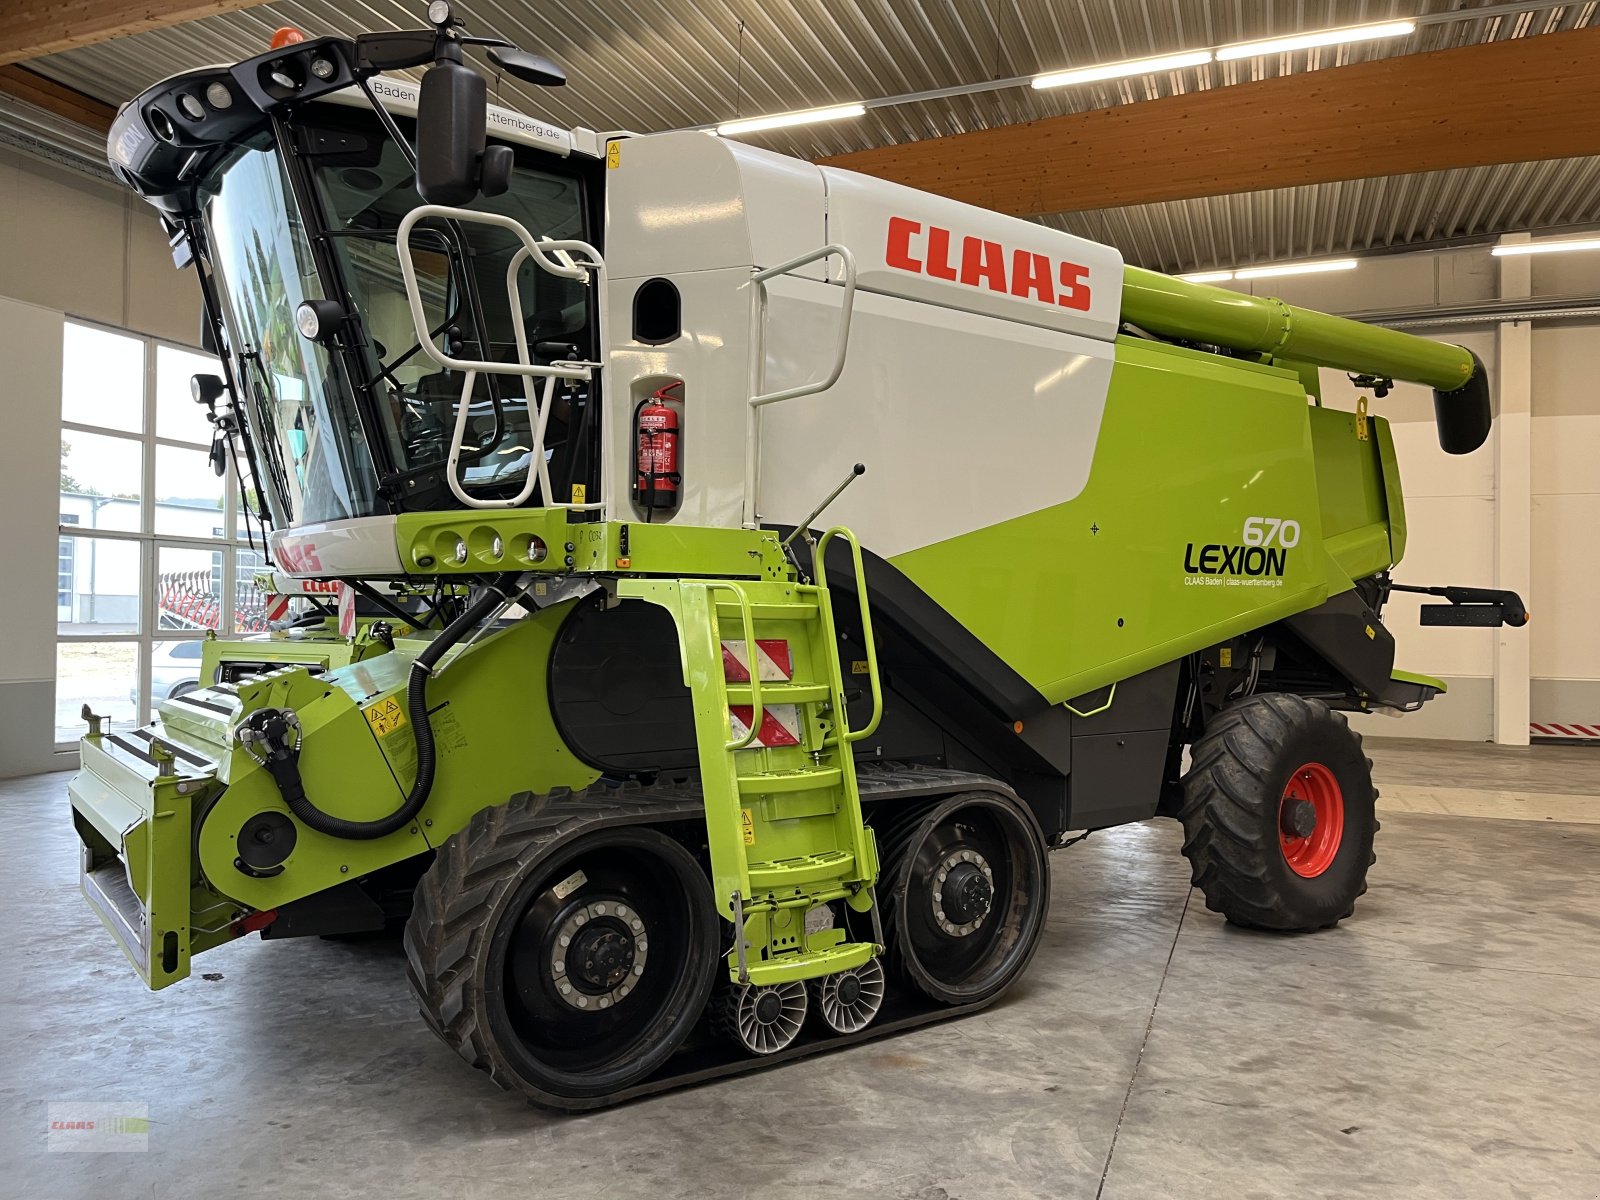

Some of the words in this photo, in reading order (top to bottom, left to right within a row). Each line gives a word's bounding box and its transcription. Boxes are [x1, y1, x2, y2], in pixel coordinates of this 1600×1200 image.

[374, 82, 416, 102] Baden
[487, 111, 560, 139] rttemberg.de
[886, 216, 1091, 312] CLAAS
[1242, 516, 1300, 548] 670
[1184, 543, 1287, 576] LEXION
[302, 580, 339, 593] CLAA
[1184, 576, 1204, 586] CLAAS
[1205, 576, 1223, 586] Baden
[1226, 577, 1283, 588] claas-wuerttemberg.de
